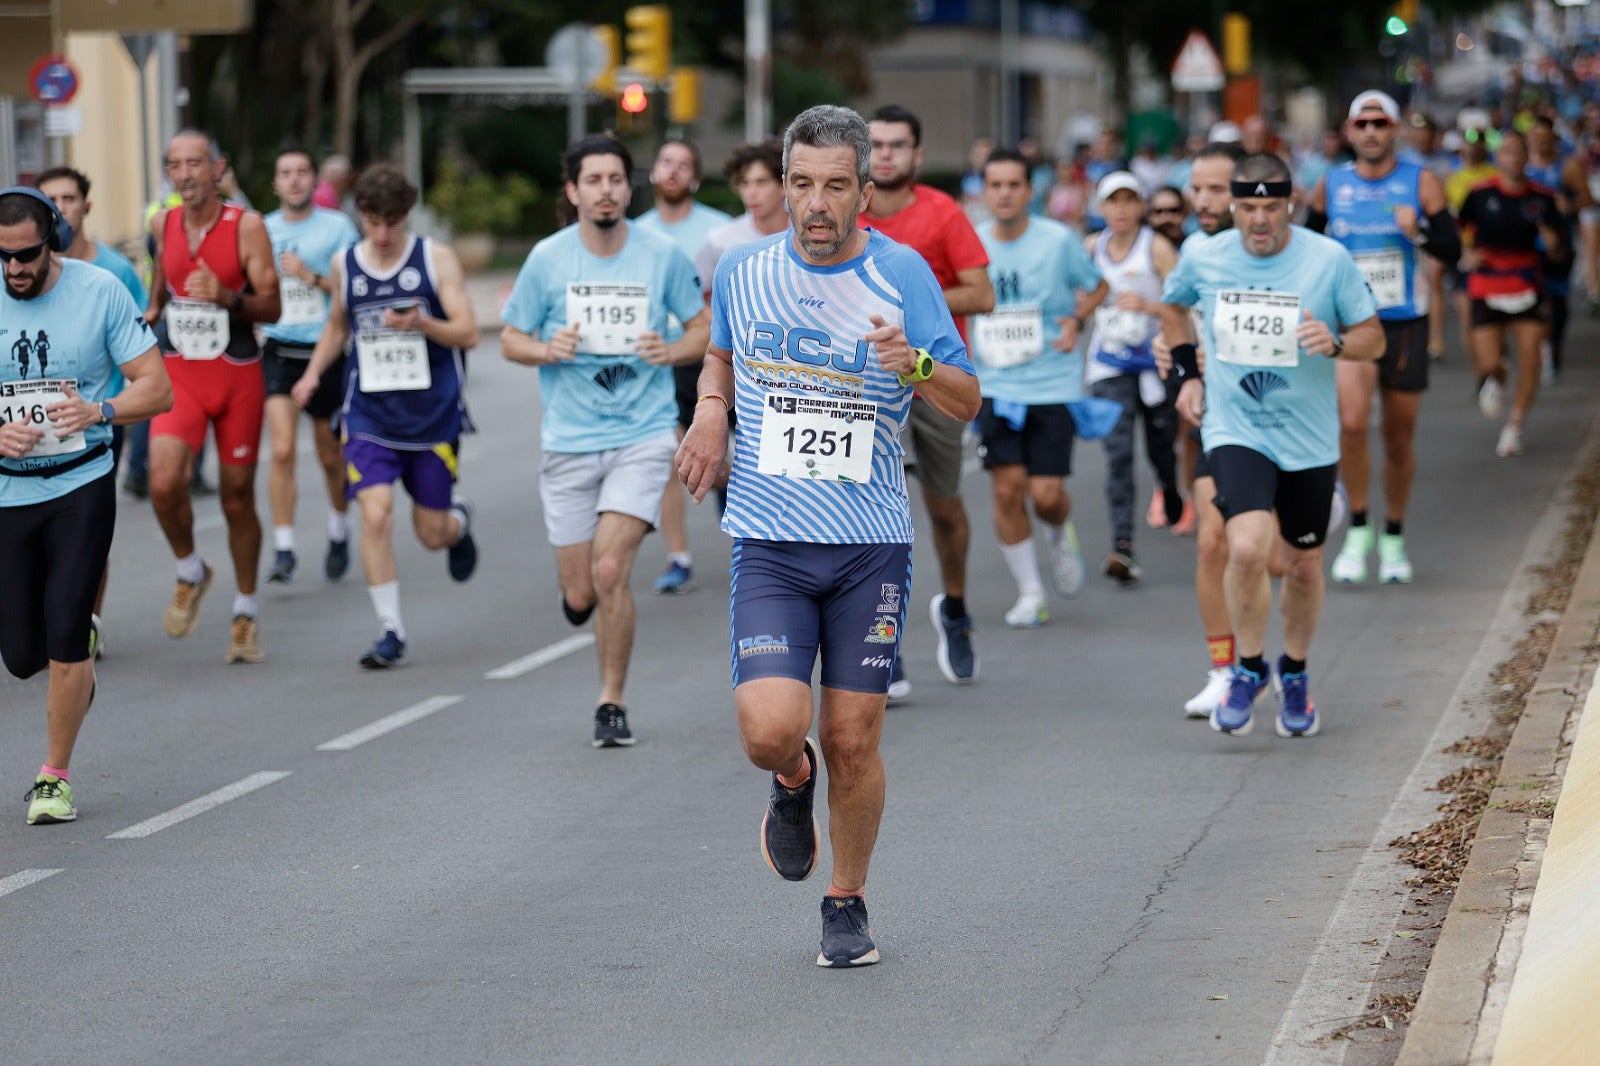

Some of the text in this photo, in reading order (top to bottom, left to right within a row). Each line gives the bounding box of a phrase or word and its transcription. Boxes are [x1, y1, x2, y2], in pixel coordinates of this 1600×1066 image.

[584, 305, 637, 324] 1195
[1229, 314, 1284, 336] 1428
[745, 320, 869, 373] RCJ
[3, 404, 57, 424] 116
[798, 398, 876, 412] CARRERA URBANA
[783, 426, 852, 458] 1251
